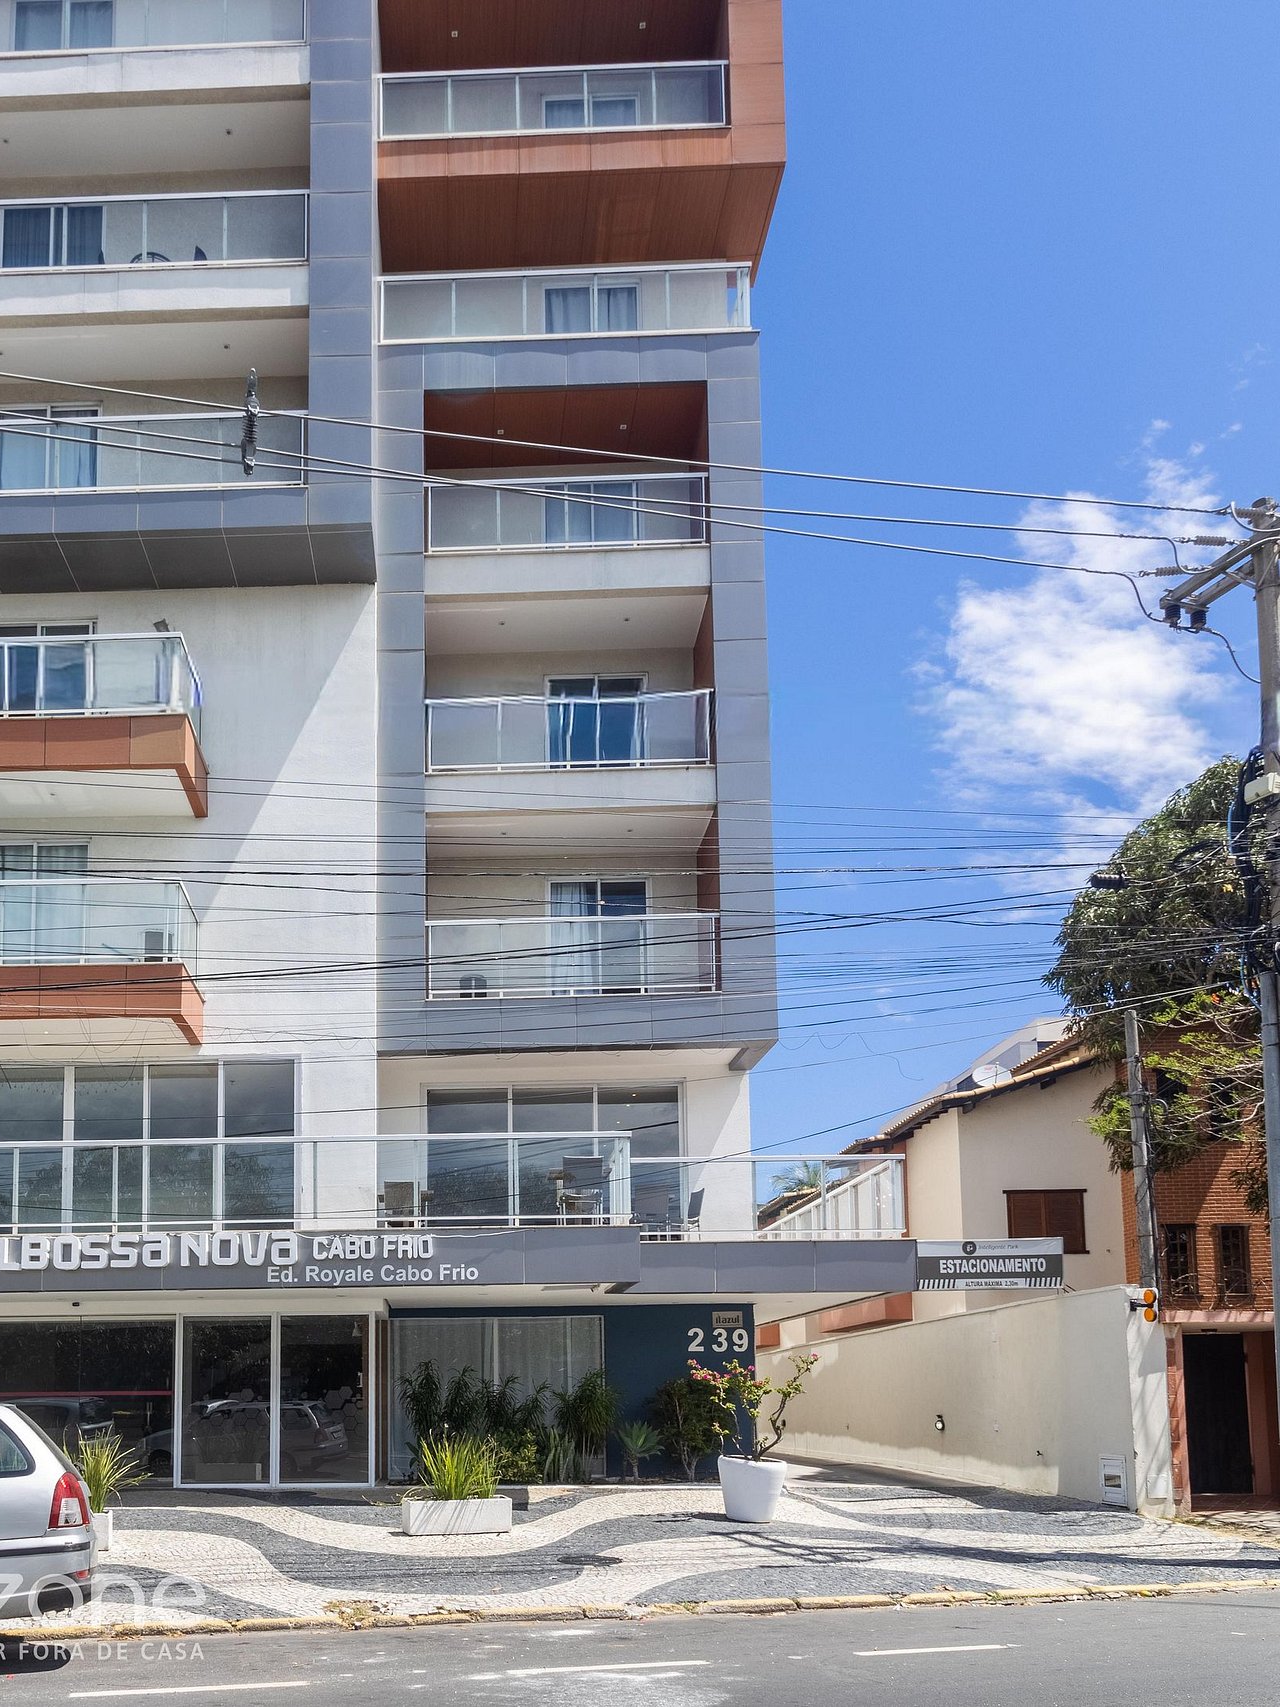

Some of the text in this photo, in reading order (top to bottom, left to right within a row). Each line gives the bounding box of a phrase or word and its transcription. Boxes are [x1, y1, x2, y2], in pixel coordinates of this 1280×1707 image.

[312, 1235, 435, 1261] CABO FRIO
[267, 1263, 480, 1287] Ed. Royale Cabo Frio
[939, 1257, 1046, 1273] ESTACIONAMENTO
[687, 1327, 749, 1352] 239
